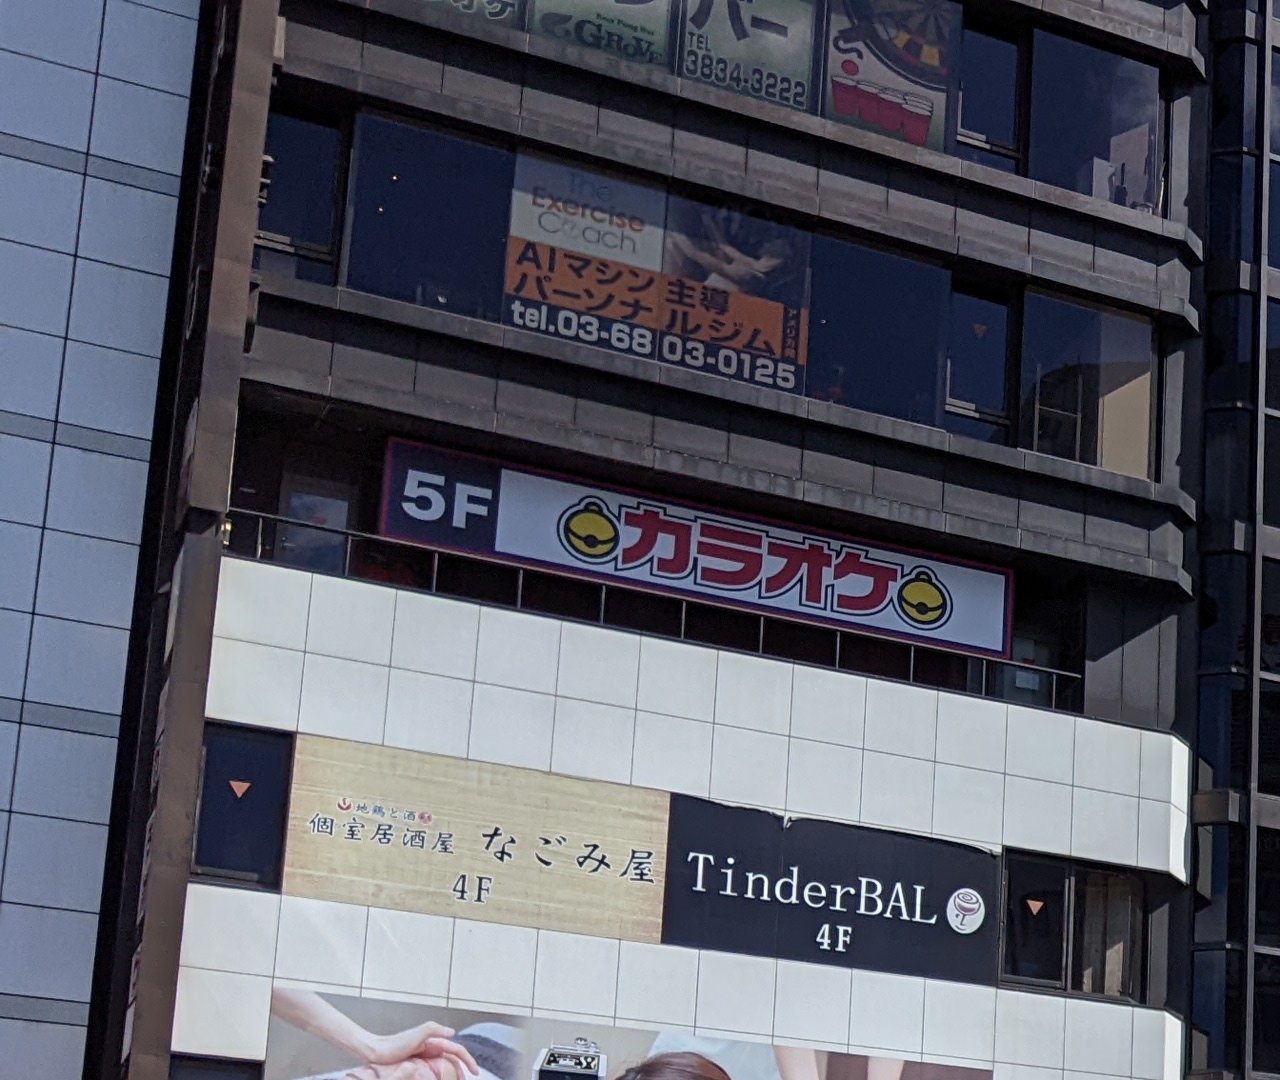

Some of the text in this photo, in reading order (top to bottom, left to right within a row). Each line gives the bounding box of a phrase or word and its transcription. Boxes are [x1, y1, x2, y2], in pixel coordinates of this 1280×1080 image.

[688, 31, 711, 51] TEL
[683, 50, 808, 108] 3834-3222
[532, 186, 644, 232] Exercise
[538, 212, 636, 252] Coach
[403, 470, 492, 530] 5F
[619, 507, 899, 611] カラオケ
[310, 813, 656, 884] 個室居酒屋 なごみ屋
[452, 874, 493, 903] 4F
[687, 854, 939, 926] TinderBAL
[816, 924, 853, 954] 4F
